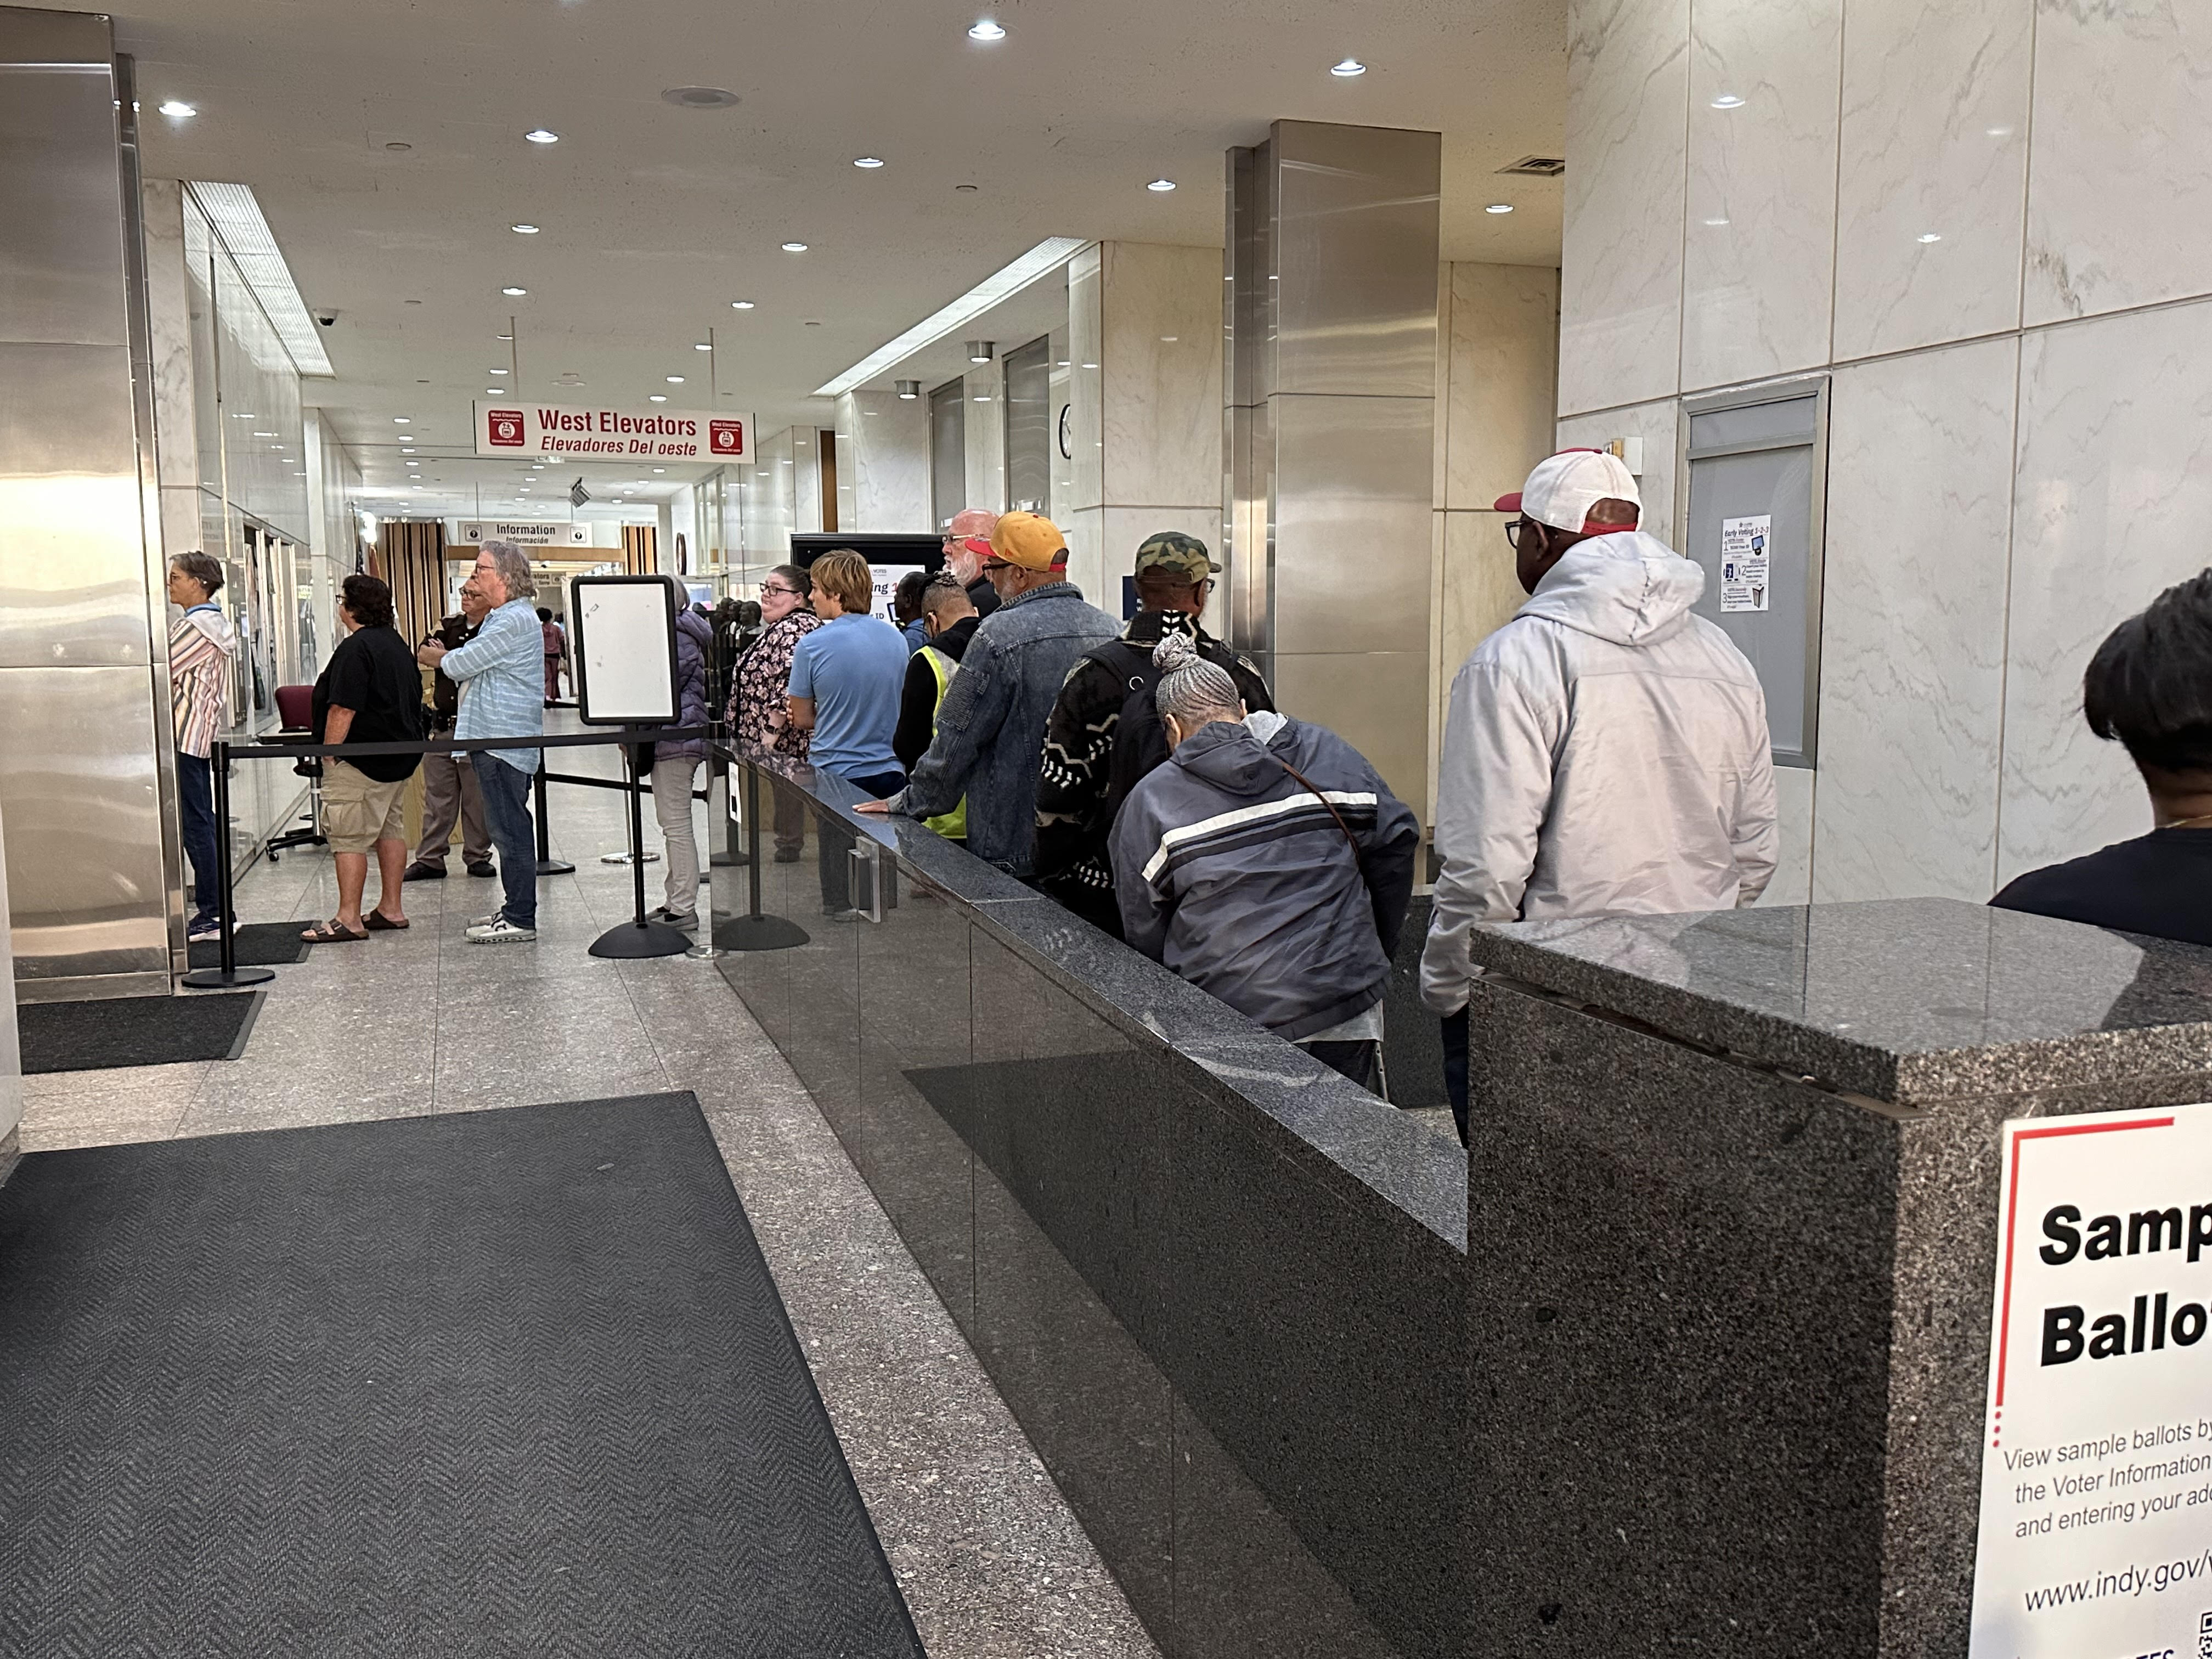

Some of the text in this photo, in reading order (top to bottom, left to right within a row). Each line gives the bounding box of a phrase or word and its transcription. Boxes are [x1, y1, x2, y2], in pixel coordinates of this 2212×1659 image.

[538, 409, 696, 436] West Elevators
[541, 436, 697, 456] Elevadores Del oeste
[496, 524, 555, 535] Information
[2040, 1292, 2212, 1367] Ballo
[2004, 1448, 2052, 1471] View
[2057, 1434, 2126, 1462] sample
[2132, 1423, 2192, 1449] ballots
[2016, 1454, 2211, 1504] the Voter Information
[2016, 1512, 2052, 1538] and
[2058, 1501, 2135, 1530] entering
[2141, 1493, 2182, 1520] your
